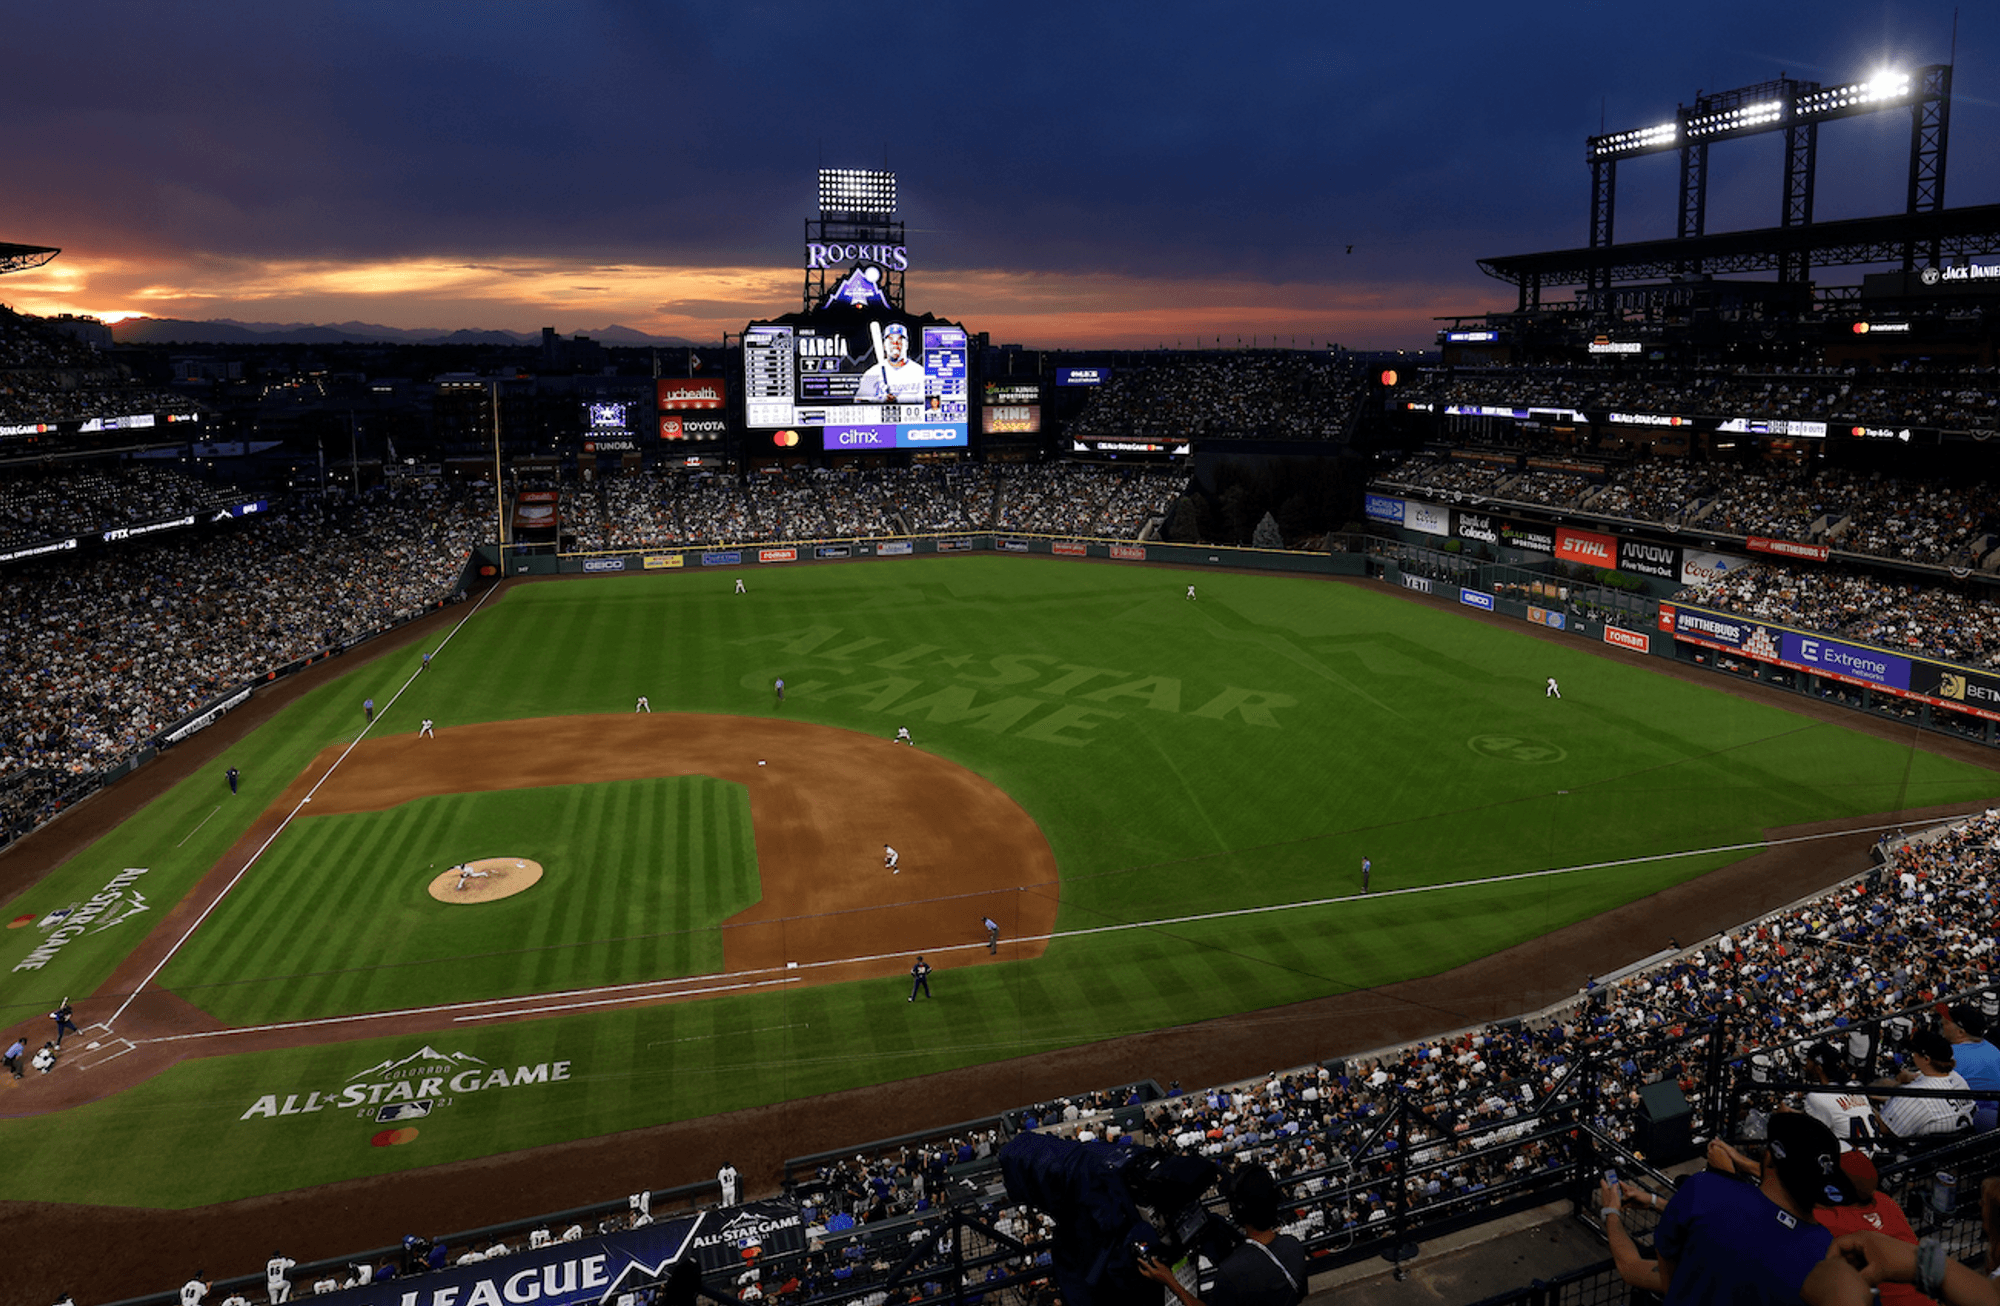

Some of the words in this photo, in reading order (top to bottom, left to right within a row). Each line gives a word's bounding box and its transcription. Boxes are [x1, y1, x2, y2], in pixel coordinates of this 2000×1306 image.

[807, 243, 908, 271] ROCKIES
[1942, 263, 1969, 280] JACK
[799, 334, 848, 356] GARCÍA
[667, 386, 717, 400] uchealth
[992, 407, 1031, 420] KING
[17, 424, 38, 435] GAME
[683, 421, 726, 432] TOYOTA
[907, 428, 957, 441] GEICO
[595, 441, 635, 450] TUNDRA
[1459, 513, 1478, 526] Bank
[1480, 516, 1490, 529] of
[111, 528, 129, 540] FTX
[1459, 525, 1497, 543] Colorado
[1562, 537, 1609, 558] STIHL
[585, 560, 622, 570] GEICO
[1621, 559, 1637, 572] Five
[1637, 561, 1658, 574] Years
[1658, 564, 1673, 577] Out
[1405, 575, 1429, 592] YETI
[1464, 593, 1490, 605] GEICO
[1678, 614, 1741, 639] #HITTHEBUDS
[1609, 630, 1644, 647] roman
[1824, 648, 1886, 675] Extreme
[1851, 667, 1885, 682] networks
[953, 654, 1297, 728] STAR
[740, 666, 1127, 748] GAME
[62, 891, 124, 927] STAR
[11, 925, 86, 973] GAME
[384, 1065, 452, 1081] COLORADO
[240, 1090, 325, 1121] ALL
[337, 1077, 444, 1108] STAR
[448, 1060, 571, 1093] GAME
[722, 1226, 758, 1242] STAR
[758, 1215, 801, 1233] GAME
